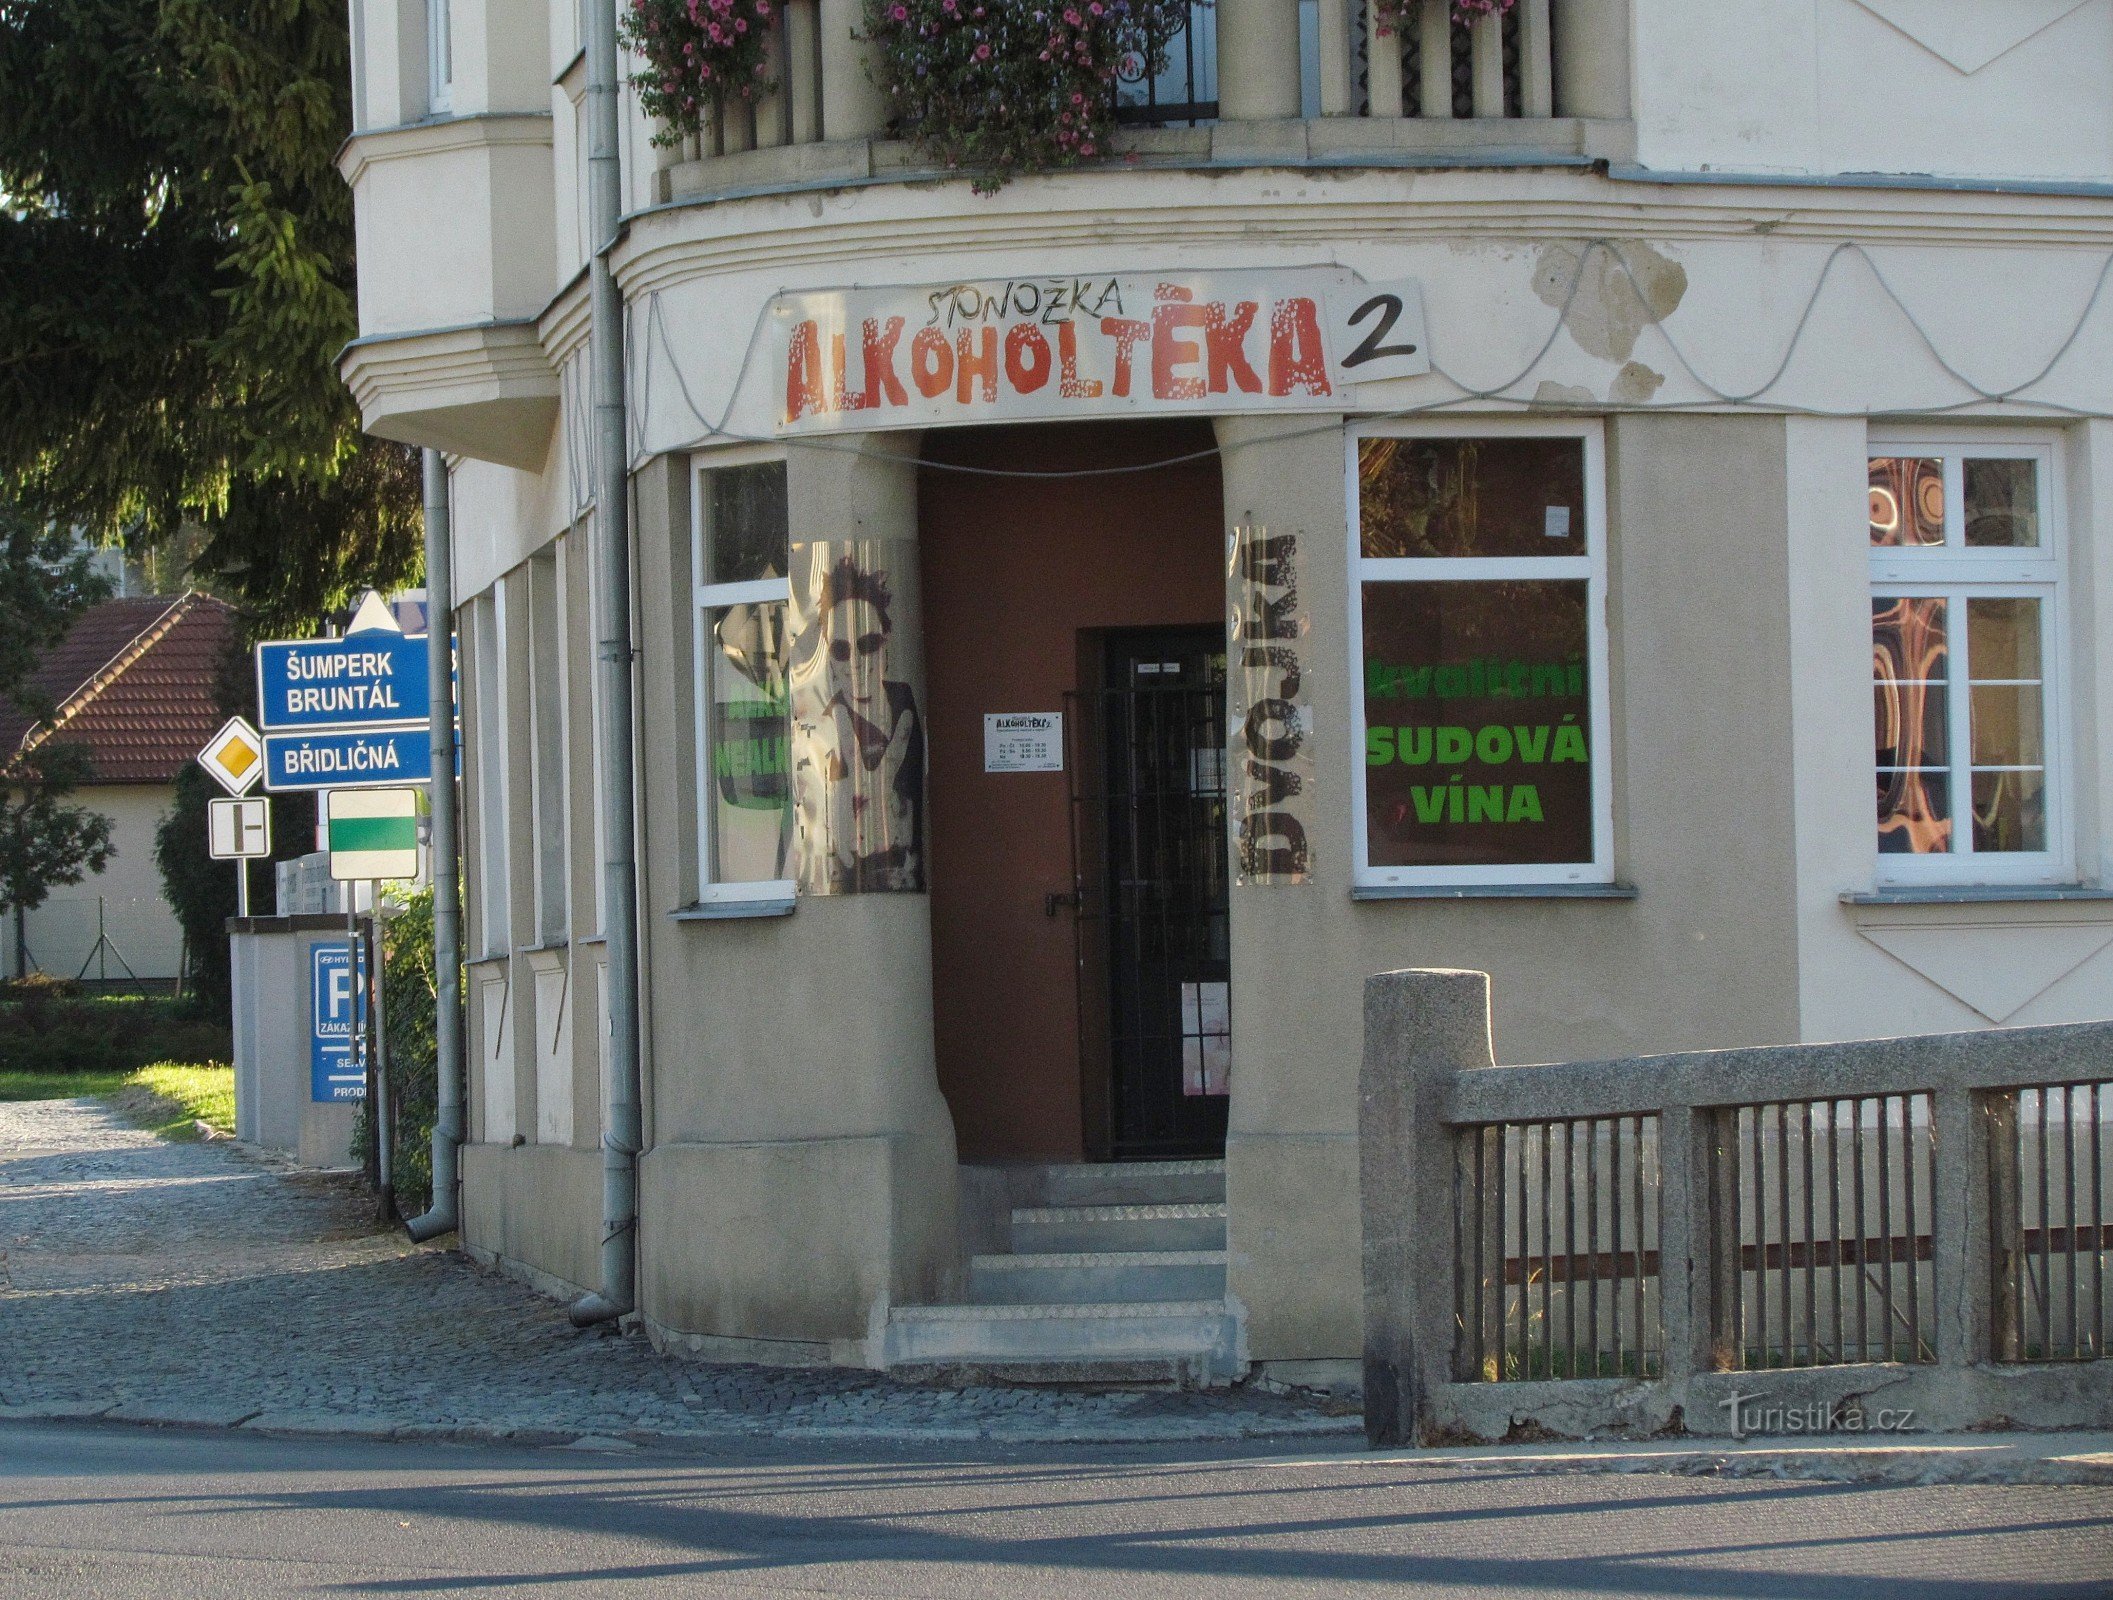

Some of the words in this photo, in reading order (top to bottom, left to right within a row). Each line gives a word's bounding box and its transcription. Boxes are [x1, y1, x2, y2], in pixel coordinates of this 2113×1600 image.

[926, 277, 1123, 329] STONOŽKA
[1340, 293, 1418, 369] 2
[286, 650, 394, 680] ŠUMPERK
[286, 680, 400, 713] BRUNTÁL
[284, 739, 400, 774] BŘIDLIČNÁ
[1366, 713, 1590, 766] SUDOVÁ
[1410, 773, 1545, 824] VÍNA
